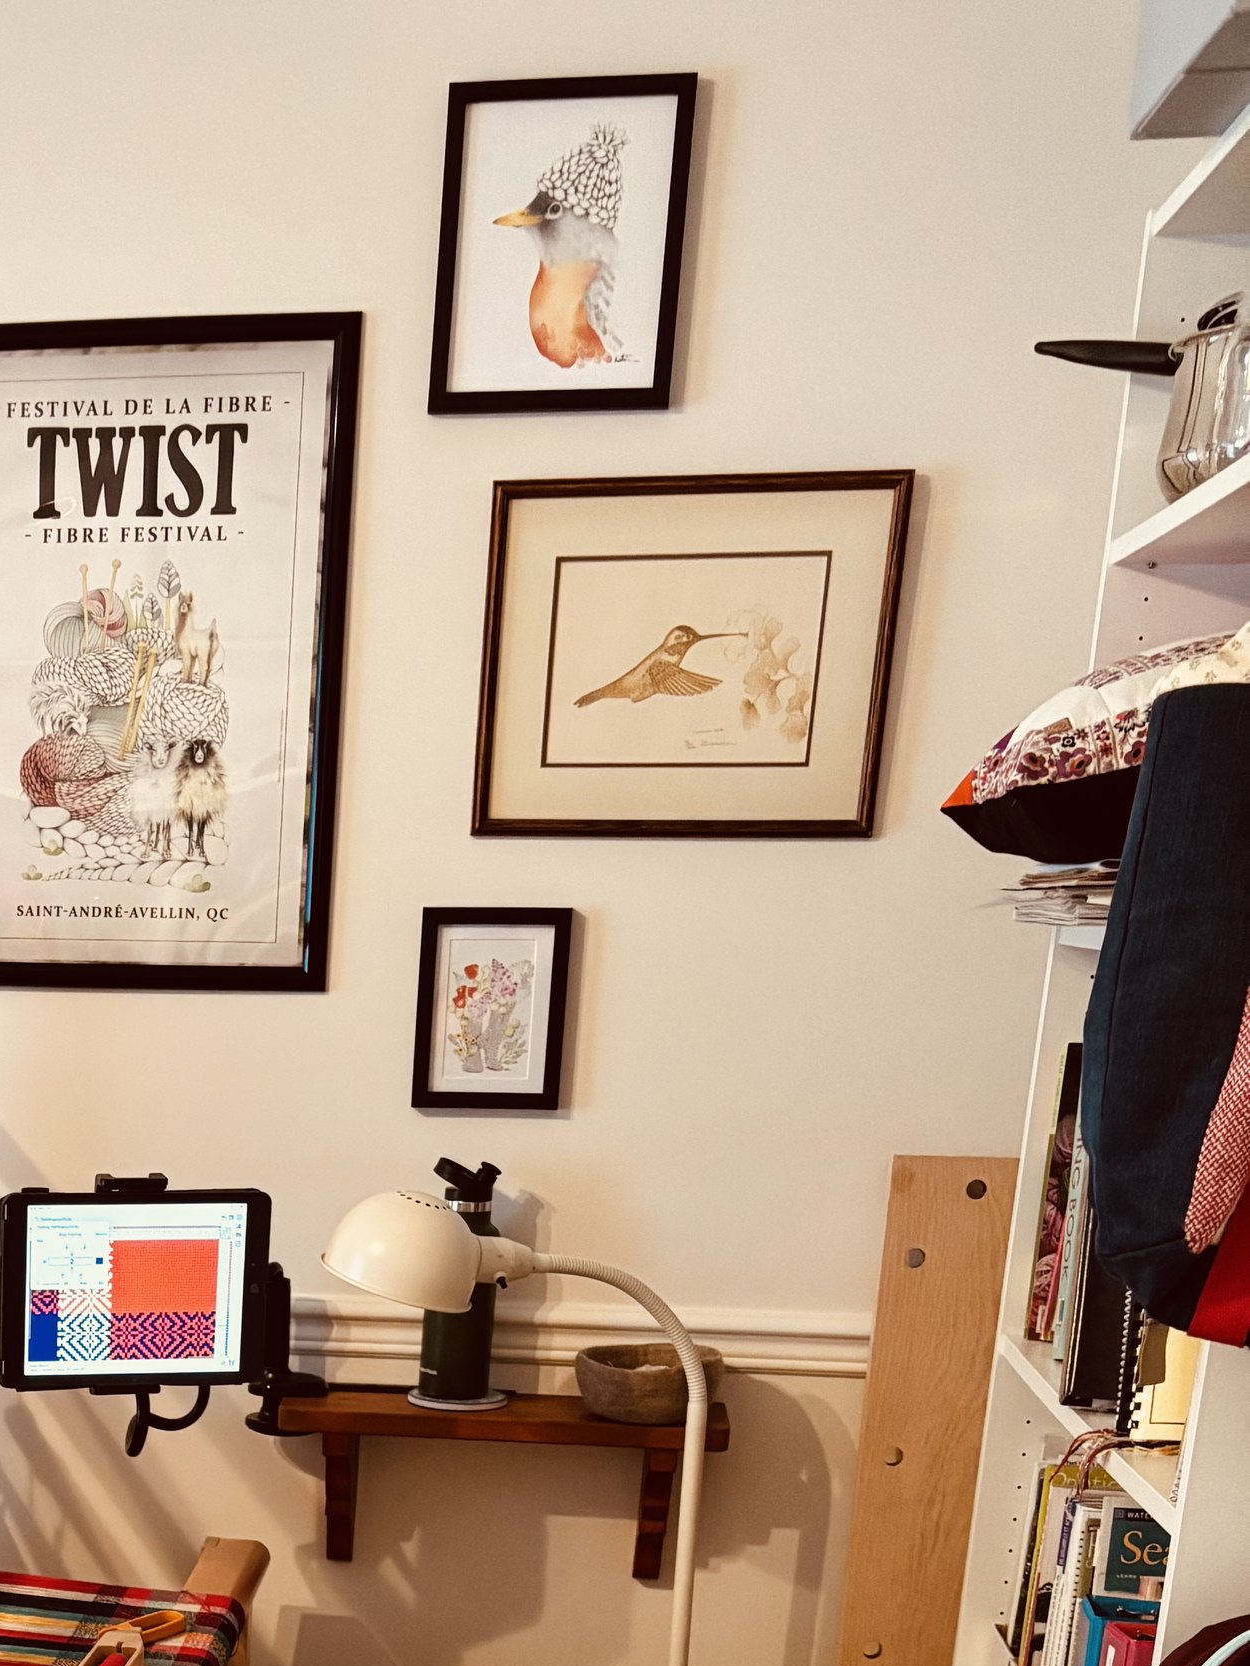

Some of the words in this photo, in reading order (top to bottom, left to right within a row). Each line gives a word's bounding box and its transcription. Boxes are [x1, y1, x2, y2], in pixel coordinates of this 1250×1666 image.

[6, 400, 114, 419] FESTIVAL
[124, 398, 155, 416] DE
[164, 397, 194, 415] LA
[203, 395, 273, 414] FIBRE
[27, 422, 249, 520] TWIST
[42, 527, 110, 544] FIBRE
[120, 525, 228, 543] FESTIVAL
[15, 902, 201, 922] SAINT-ANDRÉ-AVELLIN,
[205, 907, 230, 923] QC
[1060, 1198, 1078, 1281] BOOK
